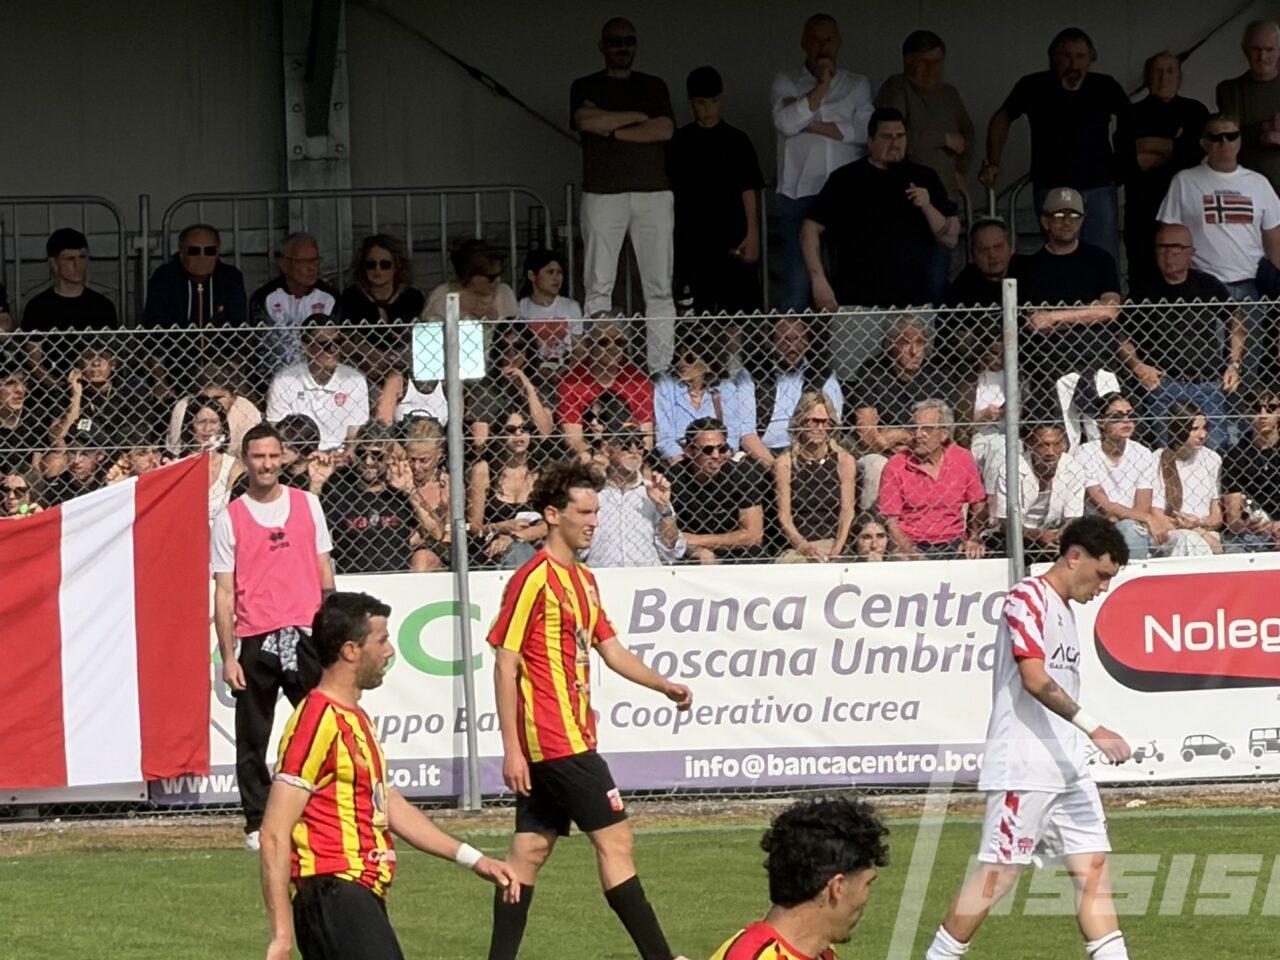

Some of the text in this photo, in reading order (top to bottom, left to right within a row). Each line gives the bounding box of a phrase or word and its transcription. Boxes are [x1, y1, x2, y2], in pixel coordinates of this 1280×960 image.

[628, 581, 1009, 635] Banca Centro
[628, 642, 817, 679] Toscana
[610, 696, 814, 735] Cooperativo
[821, 695, 921, 724] Iccrea
